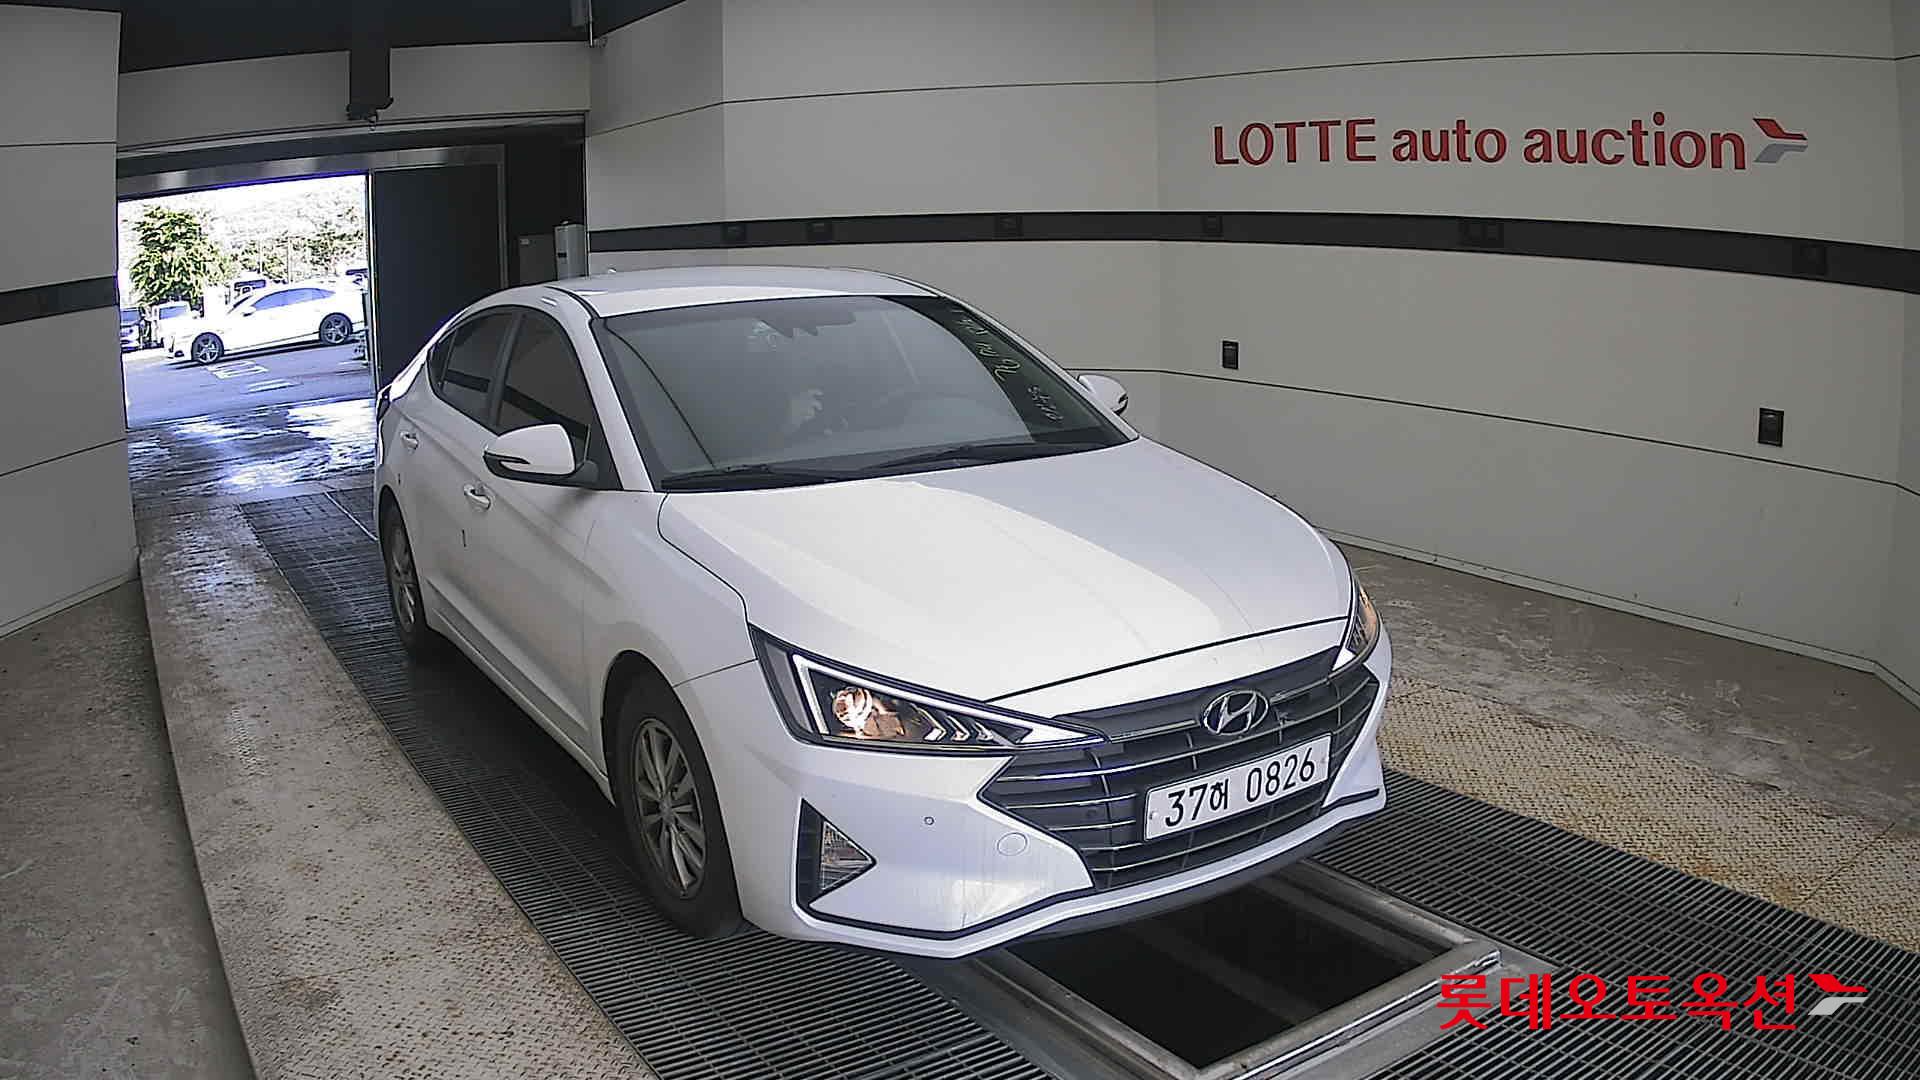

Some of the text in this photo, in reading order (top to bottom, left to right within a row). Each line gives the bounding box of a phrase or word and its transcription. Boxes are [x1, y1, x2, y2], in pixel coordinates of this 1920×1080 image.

[1213, 111, 1747, 171] LOTTE auto auction
[1165, 747, 1316, 828] 37허 0826
